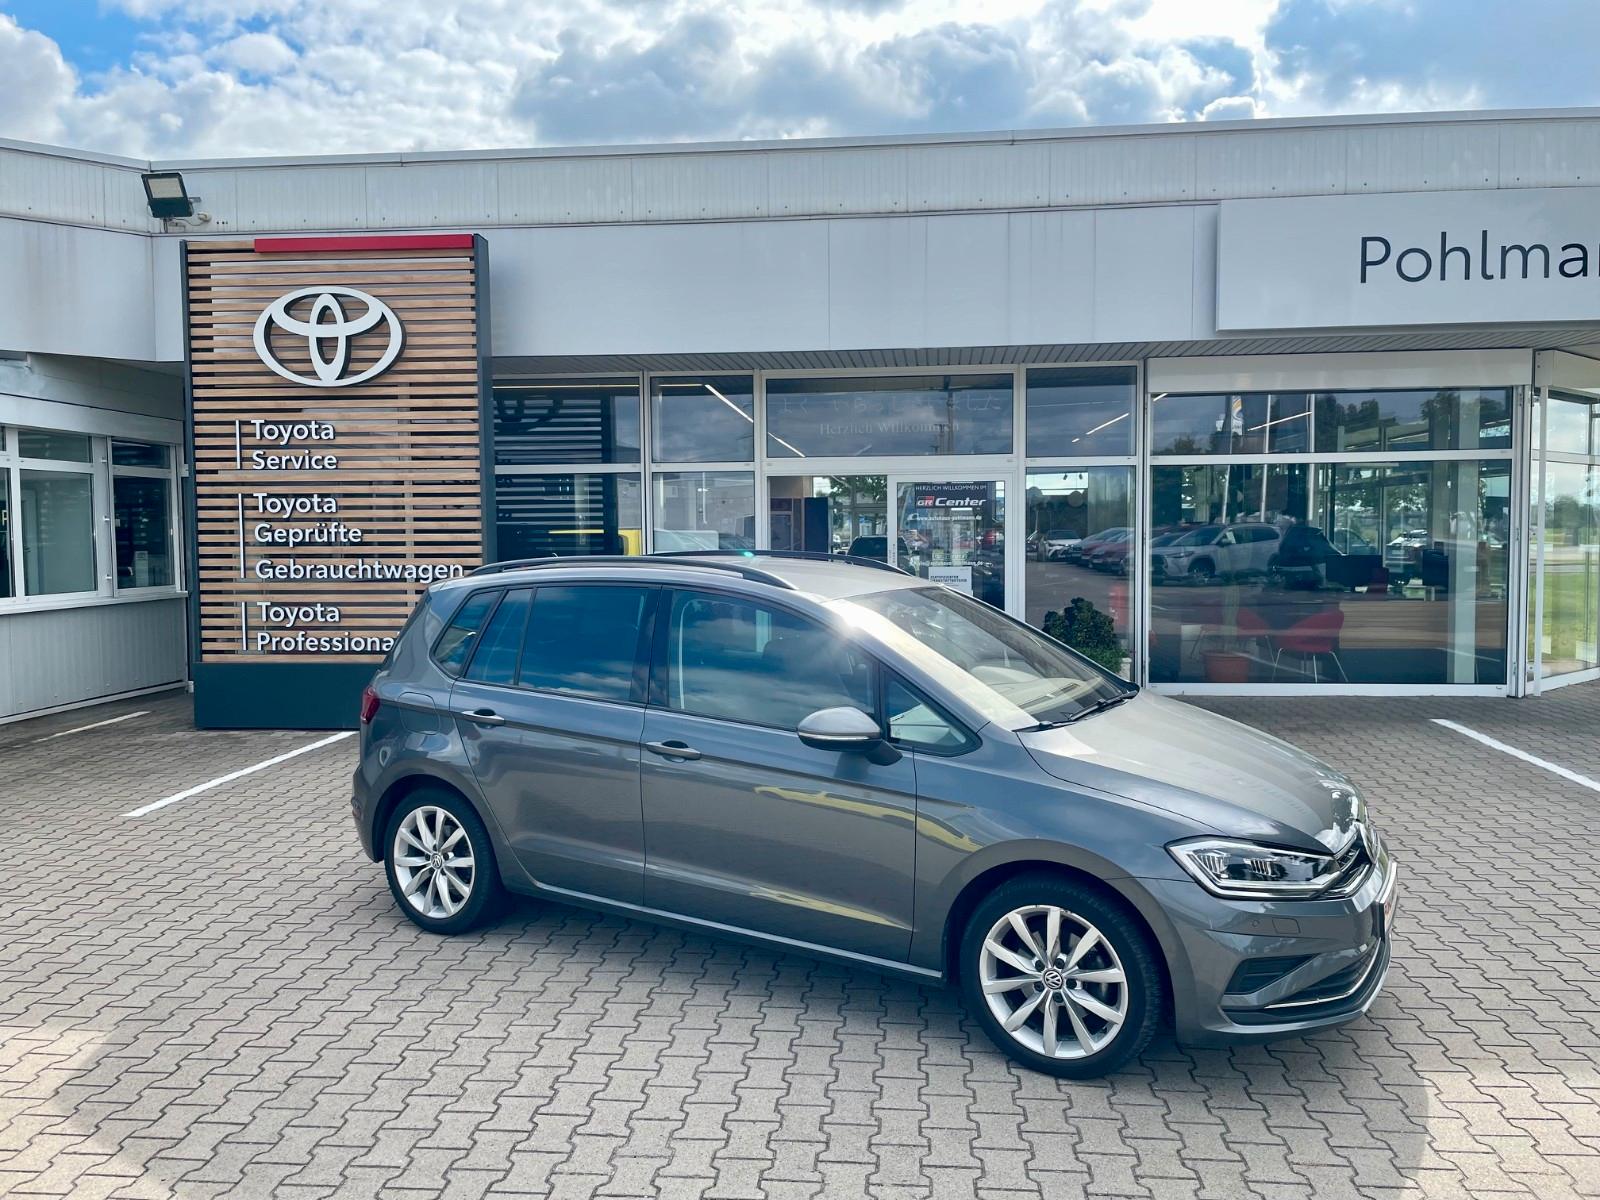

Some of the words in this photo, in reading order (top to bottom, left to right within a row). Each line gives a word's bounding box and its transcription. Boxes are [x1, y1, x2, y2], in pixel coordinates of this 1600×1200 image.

[1360, 229, 1600, 284] Pohlma
[251, 419, 336, 446] Toyota
[252, 449, 338, 470] Service
[253, 492, 337, 519] Toyota
[935, 497, 987, 507] Center
[254, 522, 362, 548] Geprüfte
[255, 559, 464, 584] Gebrauchtwagen
[256, 601, 340, 628] Toyota
[257, 631, 400, 651] Professiona
